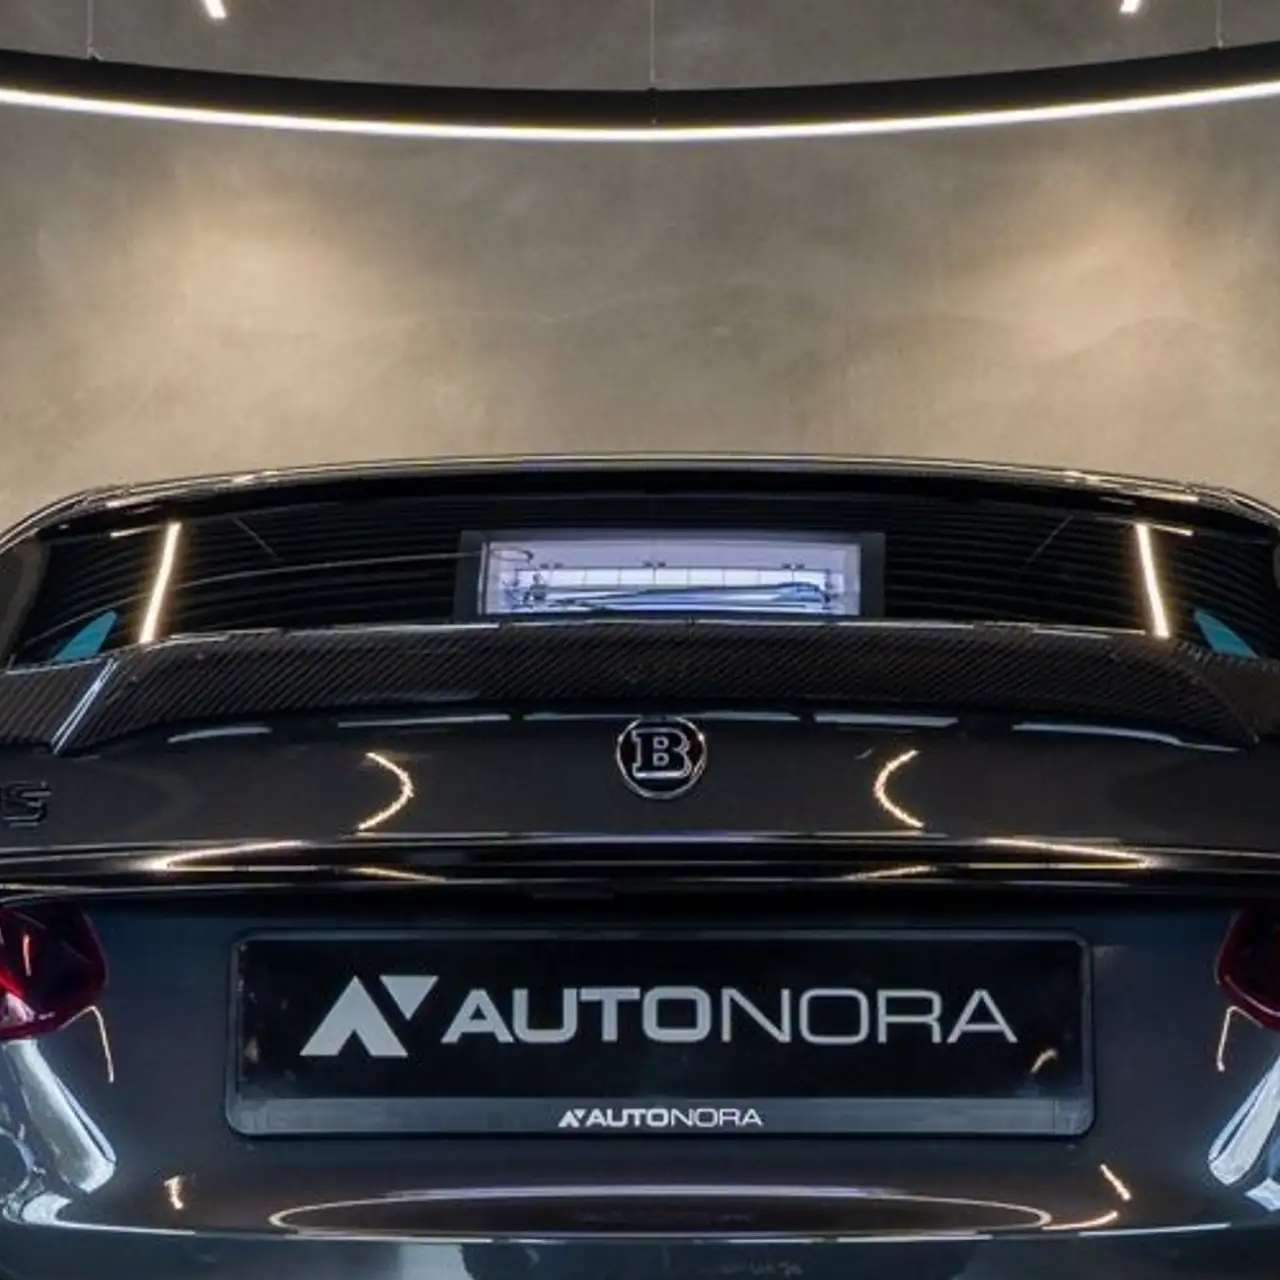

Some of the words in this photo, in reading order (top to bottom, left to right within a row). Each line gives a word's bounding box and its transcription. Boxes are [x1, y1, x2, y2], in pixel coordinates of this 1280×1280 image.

[631, 727, 694, 780] B
[441, 986, 1017, 1044] AUTONORA
[587, 1107, 762, 1128] AUTONORA
